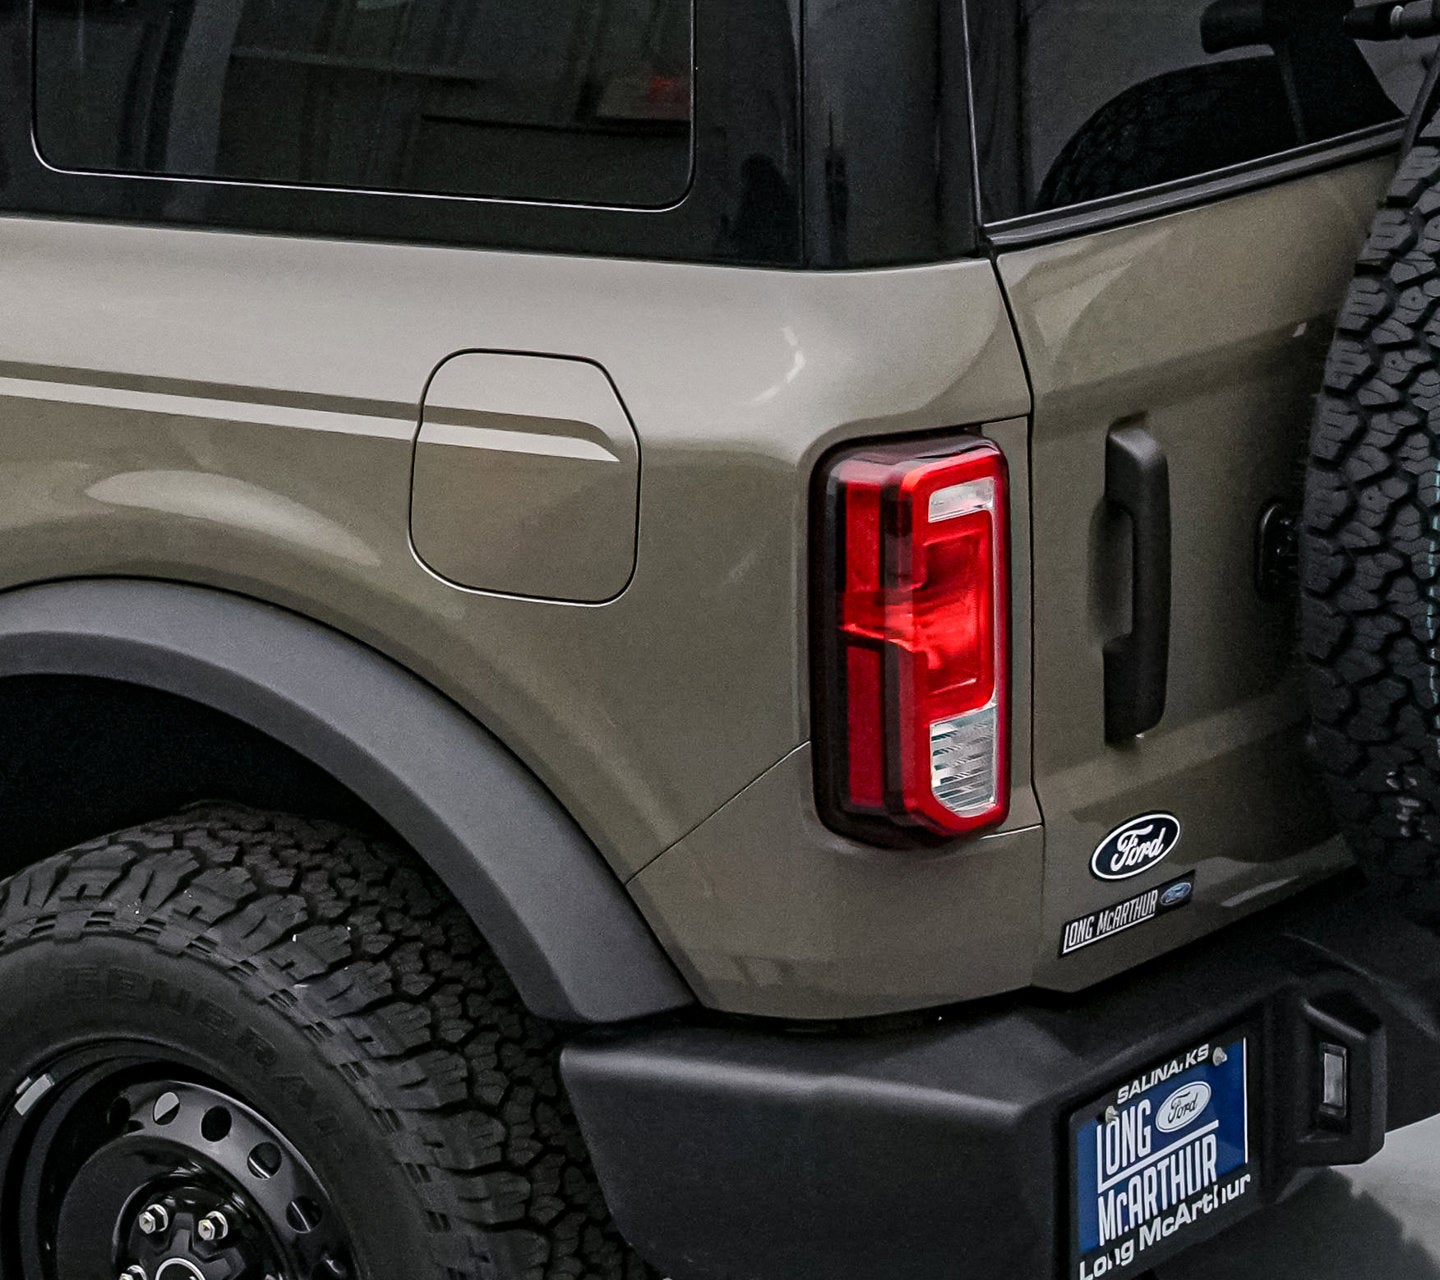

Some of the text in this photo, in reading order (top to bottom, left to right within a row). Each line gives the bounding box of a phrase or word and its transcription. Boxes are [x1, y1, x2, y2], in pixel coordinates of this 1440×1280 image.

[1110, 824, 1167, 872] Ford
[1063, 916, 1095, 954] LONG
[1185, 1043, 1210, 1069] KS
[1096, 1090, 1199, 1194] LONG Ford
